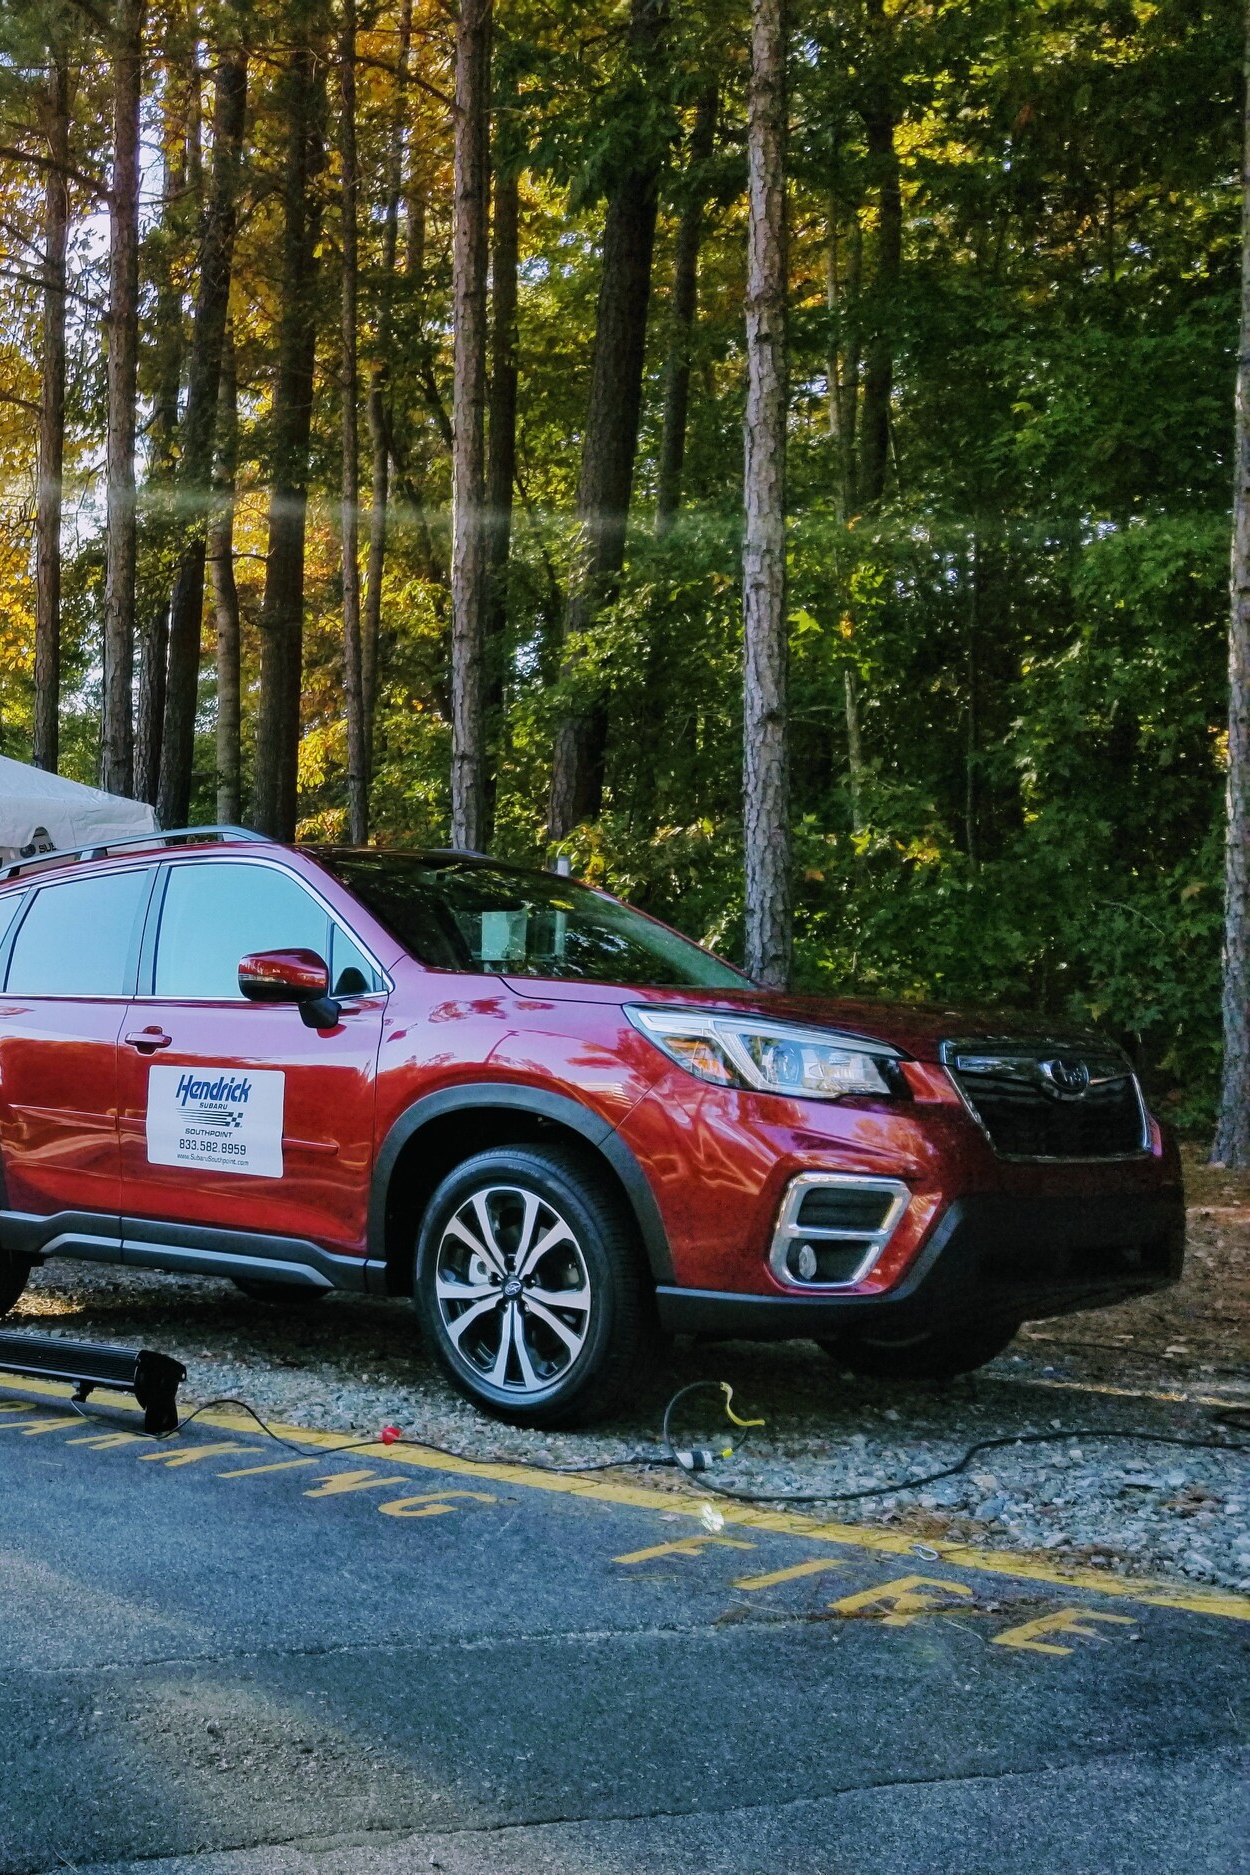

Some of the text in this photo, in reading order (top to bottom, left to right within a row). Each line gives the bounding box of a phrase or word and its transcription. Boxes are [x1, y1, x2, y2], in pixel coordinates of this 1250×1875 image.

[175, 1074, 252, 1106] Hendrick
[199, 1102, 228, 1110] SUBARU
[185, 1128, 234, 1138] SOUTHPOINT
[179, 1138, 247, 1156] 833.582.8959
[177, 1153, 249, 1167] www.SubaruSouthpoint.com
[611, 1536, 1138, 1656] FIRE
